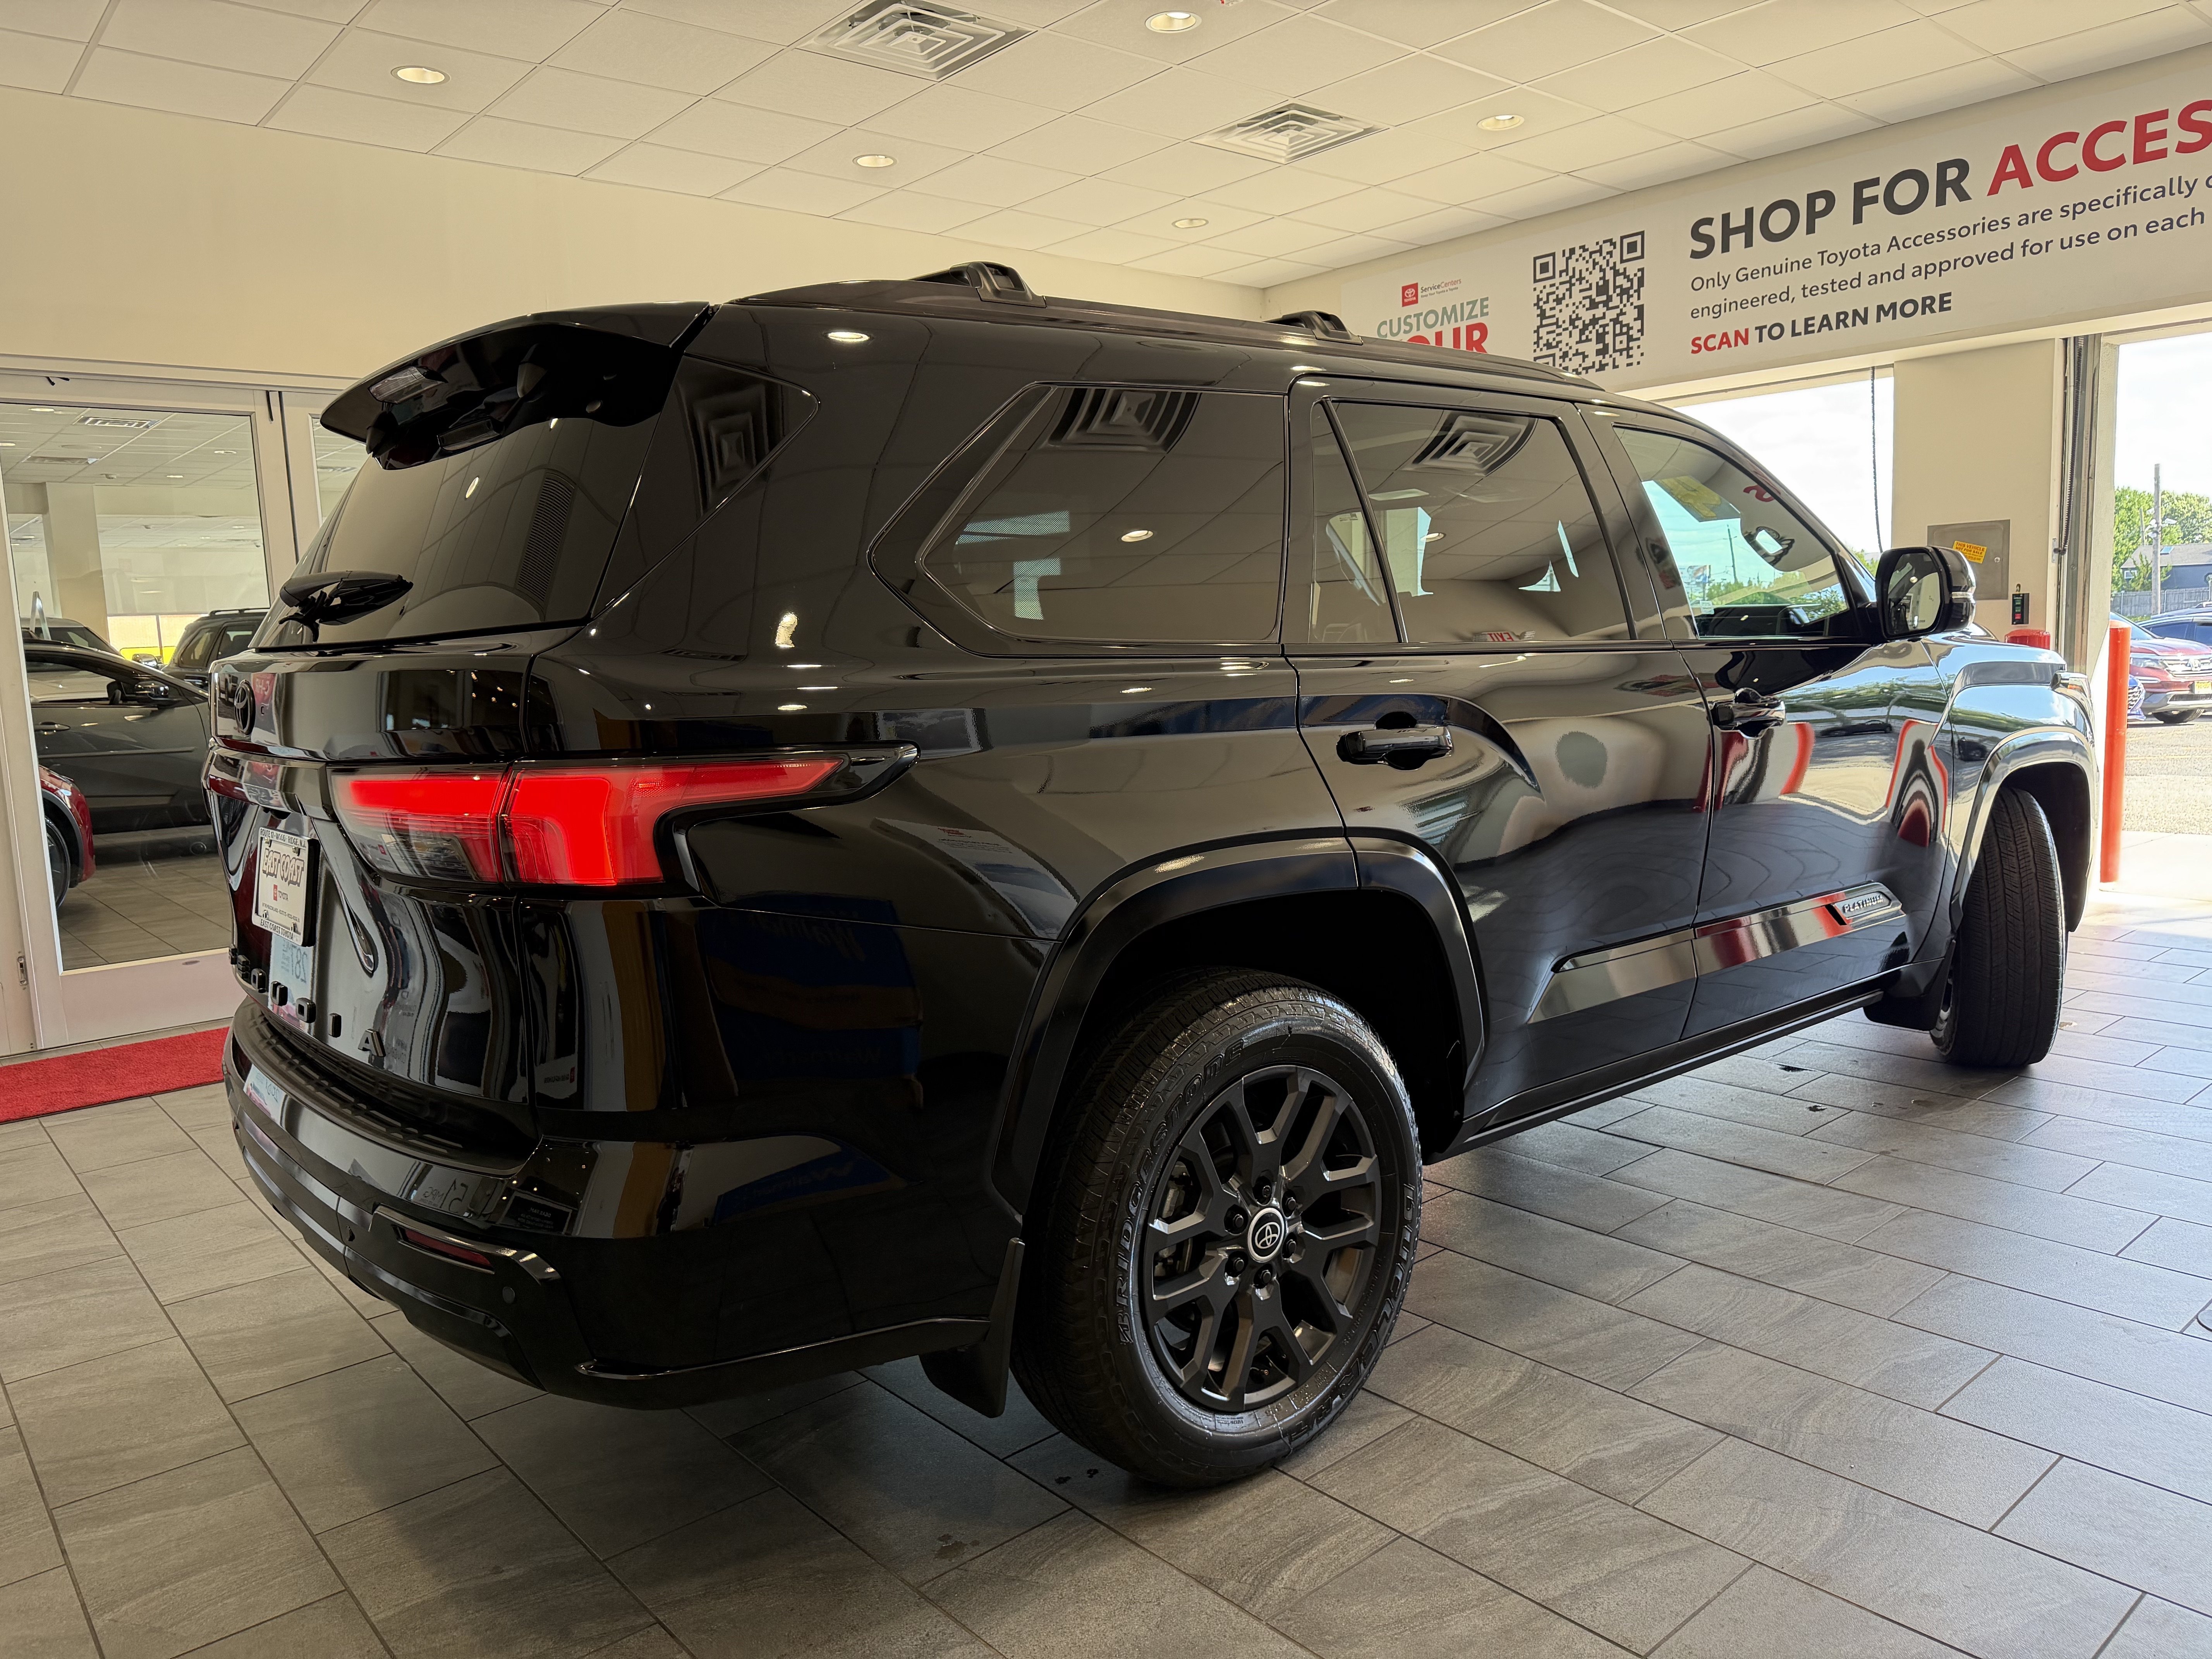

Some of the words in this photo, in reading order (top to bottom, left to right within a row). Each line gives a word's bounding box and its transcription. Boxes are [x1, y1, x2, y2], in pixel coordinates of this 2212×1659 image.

[1690, 190, 1836, 259] SHOP
[1853, 158, 1972, 225] FOR
[1987, 100, 2212, 196] ACCES
[1691, 271, 1731, 291] Only
[1736, 258, 1812, 282] Genuine
[1817, 243, 1881, 267] Toyota
[1886, 216, 2010, 253] Accessories
[2018, 208, 2053, 226] are
[2059, 175, 2198, 220] specifically
[1691, 286, 1795, 319] engineered,
[1801, 271, 1861, 298] tested
[1868, 263, 1905, 286] and
[1911, 242, 2014, 280] approved
[2021, 239, 2054, 257] for
[2060, 232, 2100, 250] use
[2107, 224, 2137, 240] on
[2146, 207, 2204, 234] each
[1420, 279, 1462, 293] ServiceCenters
[1377, 297, 1489, 338] CUSTOMIZE
[1691, 328, 1749, 354] SCAN
[1755, 322, 1785, 343] TO
[1791, 306, 1869, 337] LEARN
[1876, 292, 1952, 323] MORE
[260, 828, 270, 837] ROUTE
[262, 848, 281, 878] EAST
[280, 854, 305, 887] COAST
[278, 890, 289, 902] TOYOTA
[1842, 894, 1884, 913] PLATINUM
[260, 919, 269, 929] EAST
[269, 922, 281, 934] COAST
[281, 926, 294, 940] TOYOTA
[1115, 1039, 1245, 1345] BRIDGESTONE
